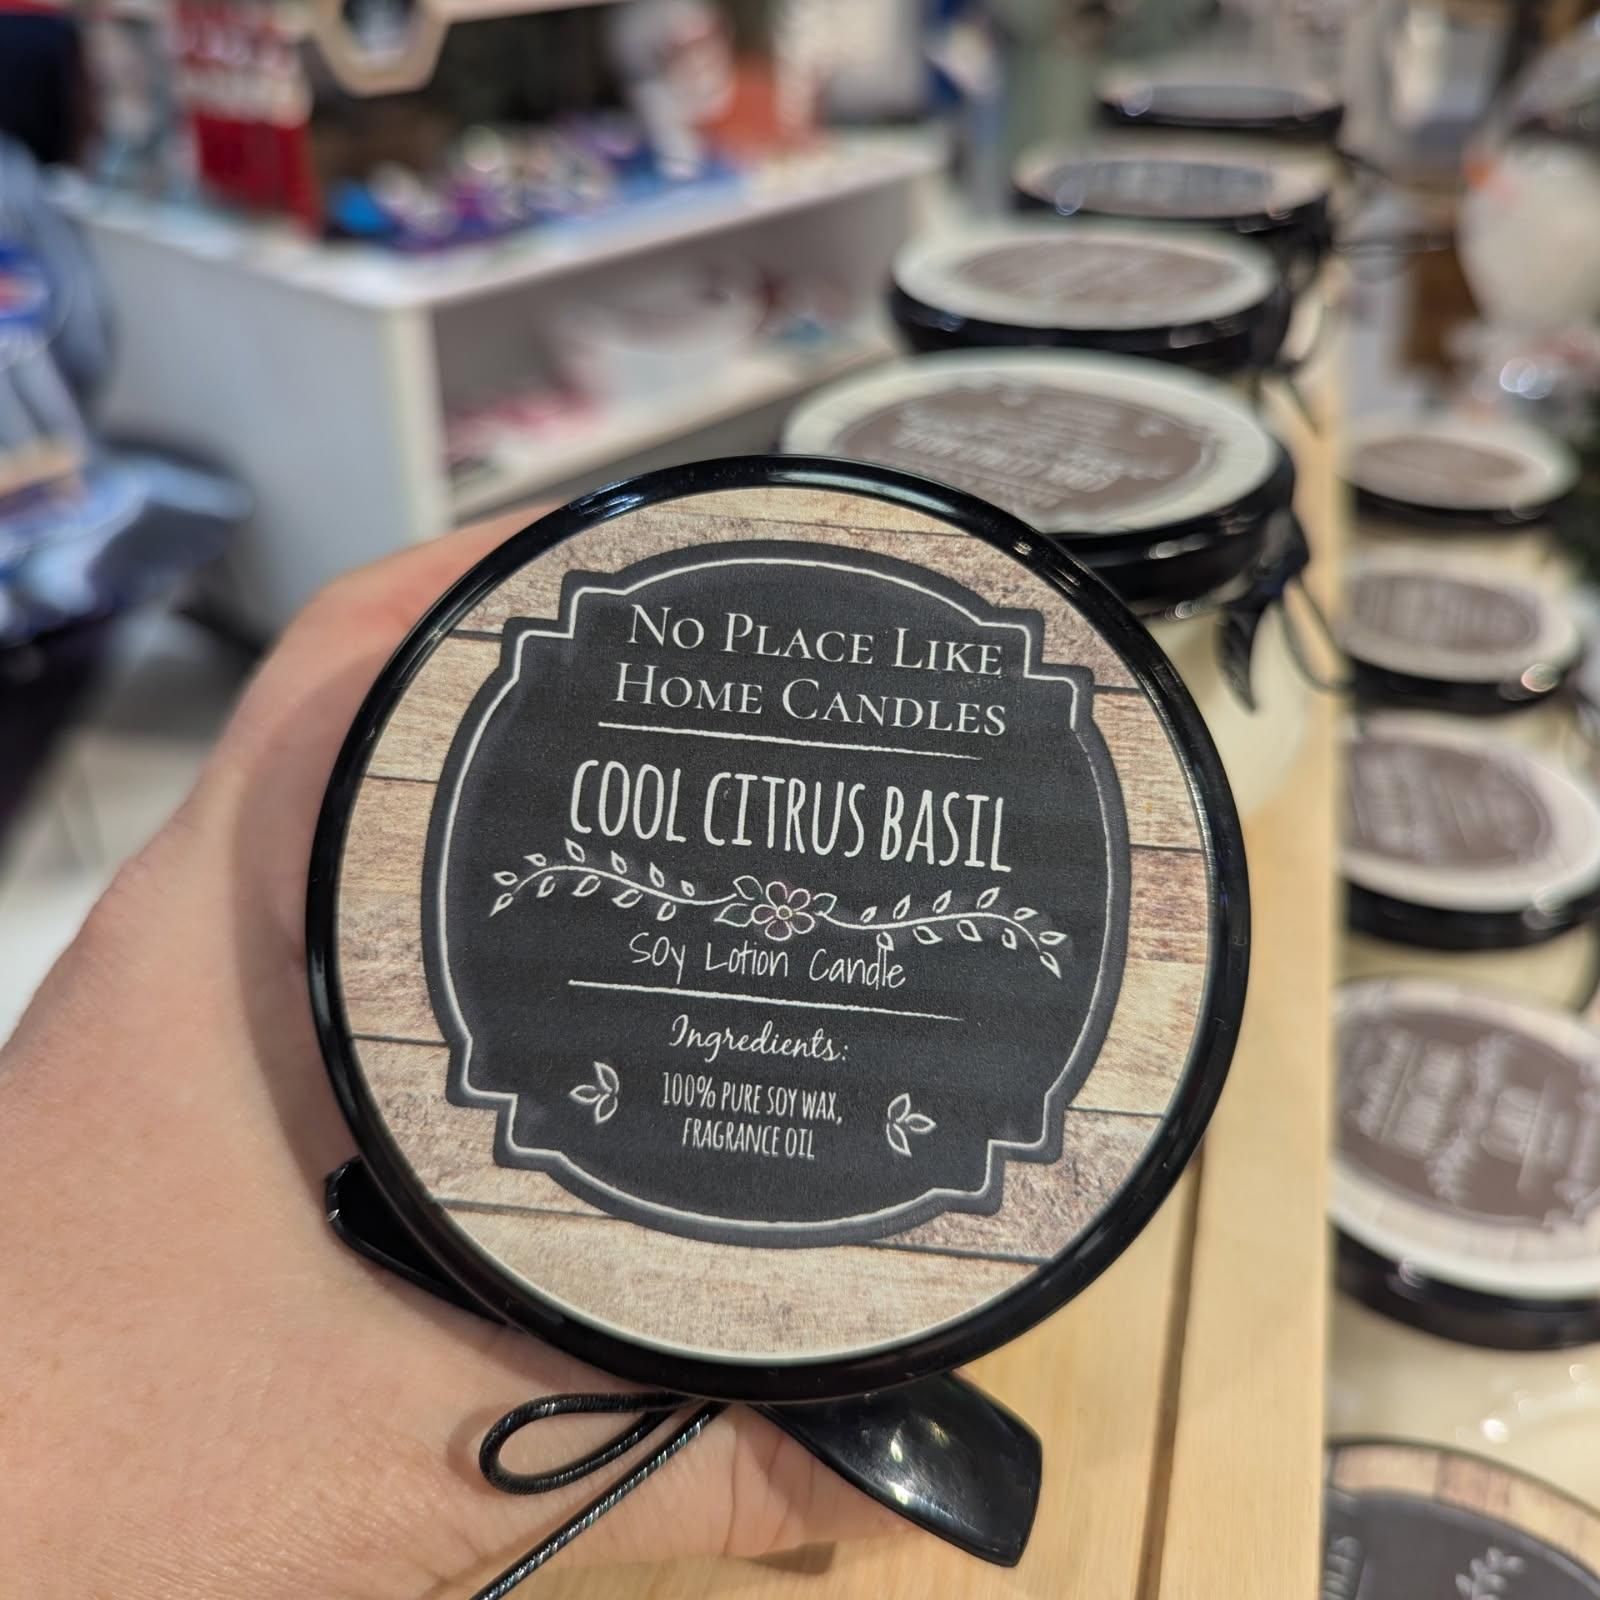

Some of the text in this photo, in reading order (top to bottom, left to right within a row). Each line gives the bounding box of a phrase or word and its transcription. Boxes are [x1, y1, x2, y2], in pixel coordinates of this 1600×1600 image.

[569, 759, 1012, 873] COOL CITRUS BASIL
[705, 937, 790, 977] Lotion
[808, 946, 906, 990] Candle
[668, 1014, 849, 1063] Ingredients:
[662, 1071, 843, 1125] 100% PURE SOY WAX,
[681, 1117, 815, 1161] FRAGRANCE OIL
